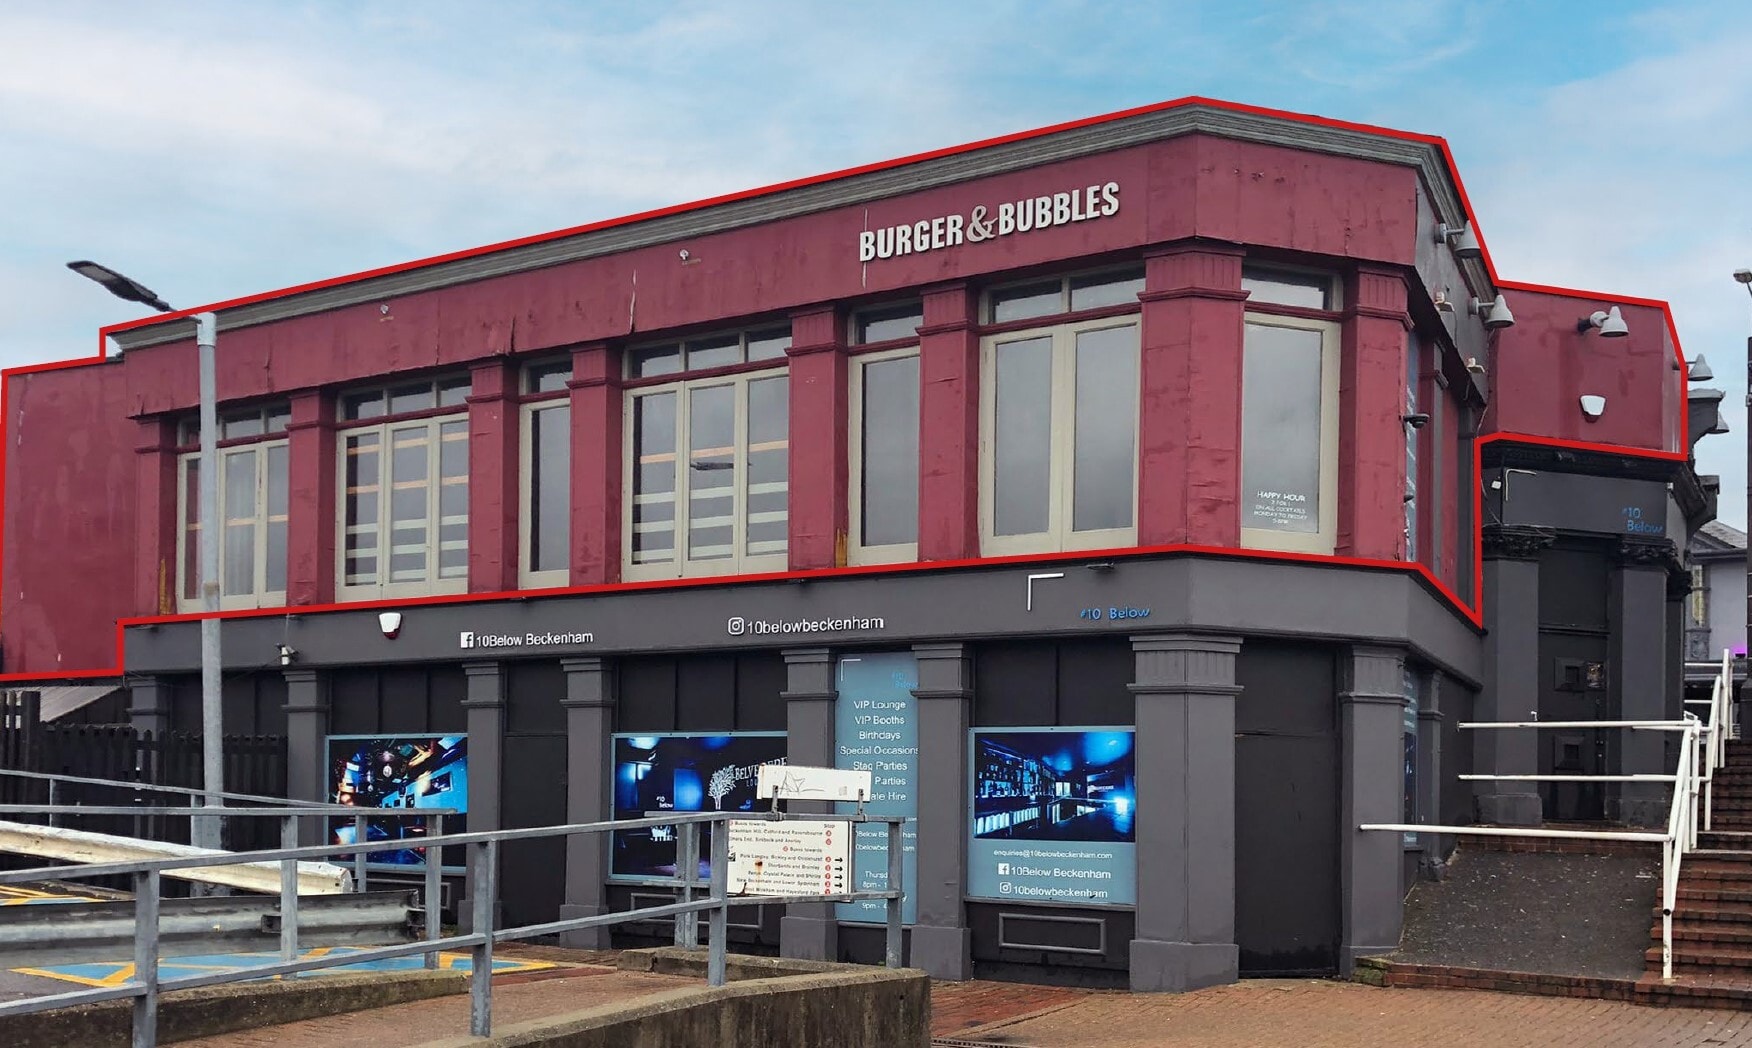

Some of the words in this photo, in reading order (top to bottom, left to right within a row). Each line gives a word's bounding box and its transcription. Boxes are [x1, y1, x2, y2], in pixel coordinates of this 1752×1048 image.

[1257, 490, 1281, 499] HAPPY
[1627, 519, 1663, 533] Below
[1109, 606, 1151, 619] Below
[747, 615, 884, 635] 10belowbeckenham
[476, 634, 523, 648] 10Below
[525, 632, 594, 645] Beckenham
[853, 700, 870, 709] VIP
[872, 700, 907, 711] Lounge
[854, 716, 871, 725] VIP
[873, 715, 905, 725] Booths
[859, 730, 901, 742] Birthdays
[840, 745, 871, 757] Special
[876, 761, 908, 771] Parties
[874, 776, 906, 786] Parties
[888, 791, 906, 801] Hire
[1011, 866, 1051, 877] 10Below
[1053, 867, 1112, 879] Beckenham
[1013, 885, 1108, 898] 10belowbeckenham
